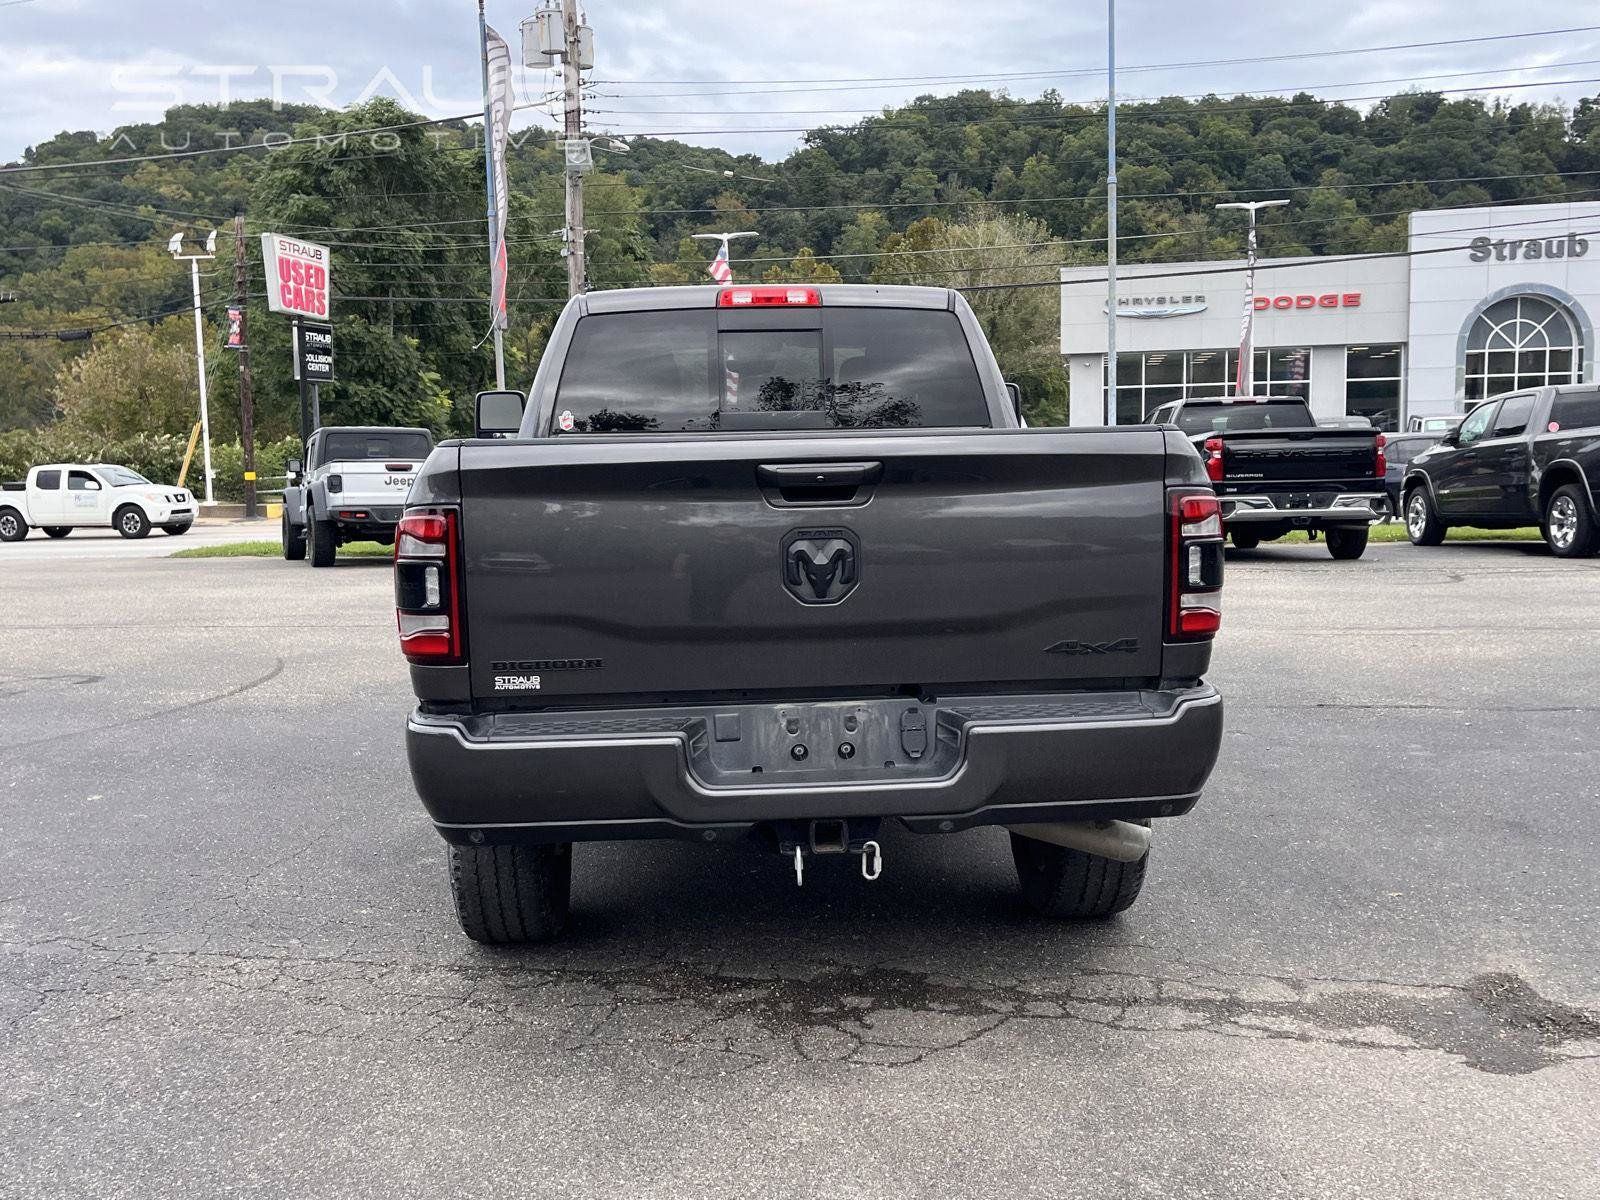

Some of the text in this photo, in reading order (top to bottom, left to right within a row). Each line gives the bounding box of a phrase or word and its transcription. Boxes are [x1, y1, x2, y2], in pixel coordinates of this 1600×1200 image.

[279, 240, 323, 260] STRAUB
[1469, 232, 1589, 262] Straub
[278, 256, 325, 290] USED
[280, 284, 326, 316] CARS
[1253, 293, 1361, 310] DODGE
[305, 331, 332, 344] STRAUB
[307, 363, 330, 372] CENTER
[385, 476, 414, 487] Jeep
[494, 675, 540, 684] STRAUB
